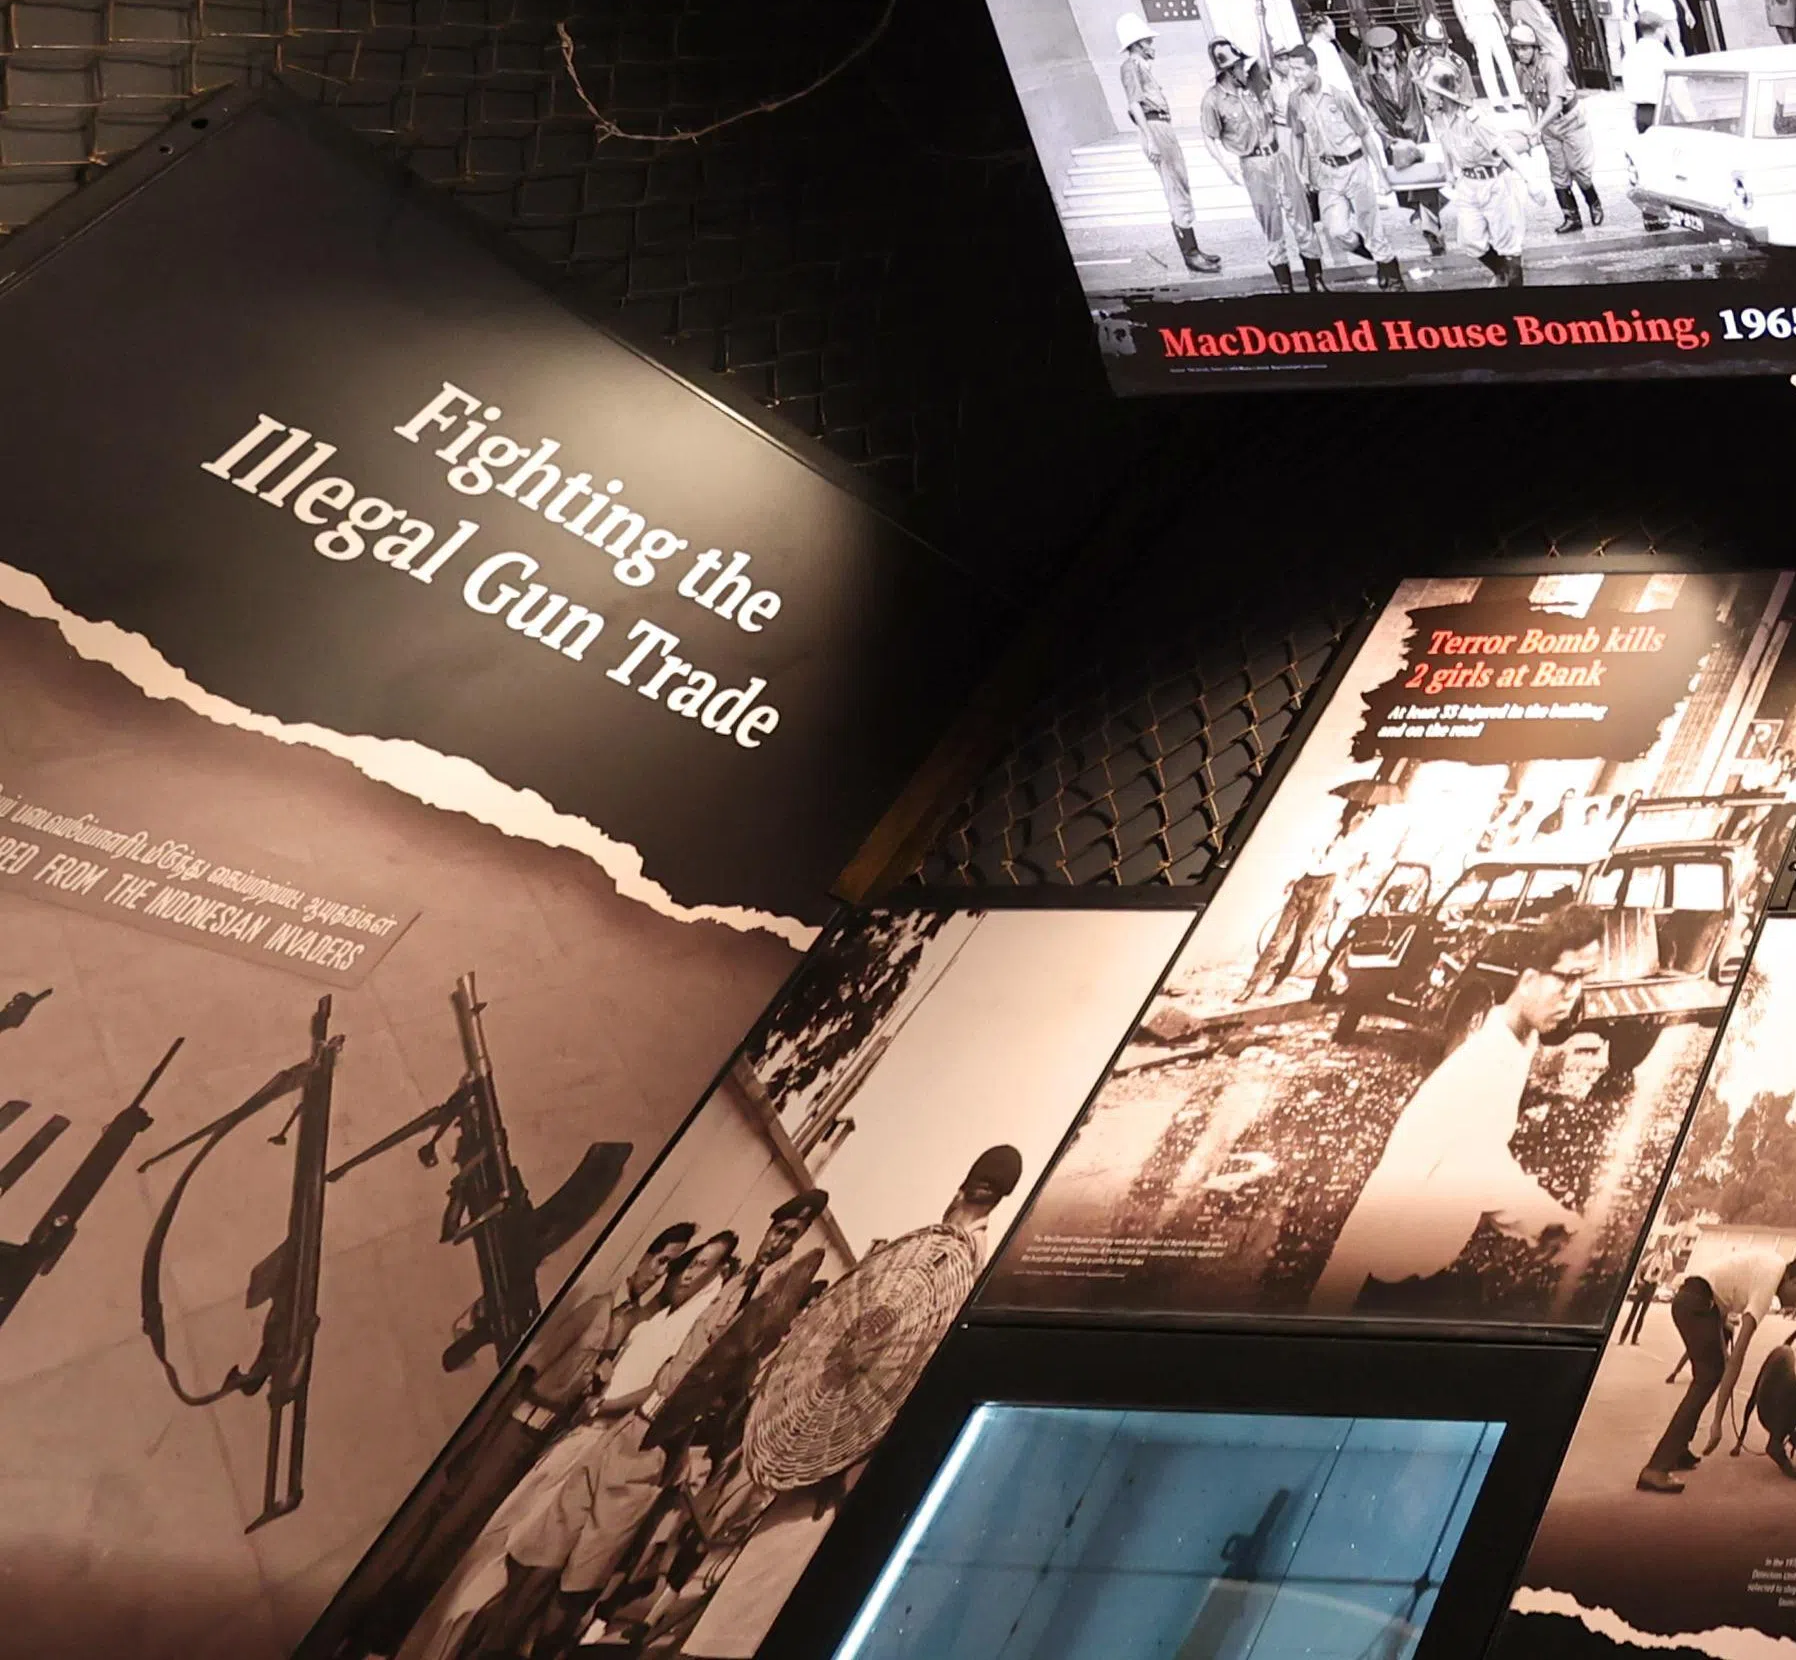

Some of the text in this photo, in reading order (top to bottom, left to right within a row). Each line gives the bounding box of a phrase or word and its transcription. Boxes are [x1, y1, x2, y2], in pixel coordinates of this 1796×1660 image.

[1160, 320, 1376, 358] MacDonald
[1383, 318, 1506, 352] House
[1514, 311, 1710, 350] Bombing,
[394, 381, 782, 633] Fighting the
[201, 413, 781, 749] Illegal Gun Trade
[1405, 660, 1607, 695] 2 girls at Bank
[1427, 626, 1666, 655] Terror Bomb kills
[33, 853, 365, 971] FROM THE INDONESIAN INVADERS
